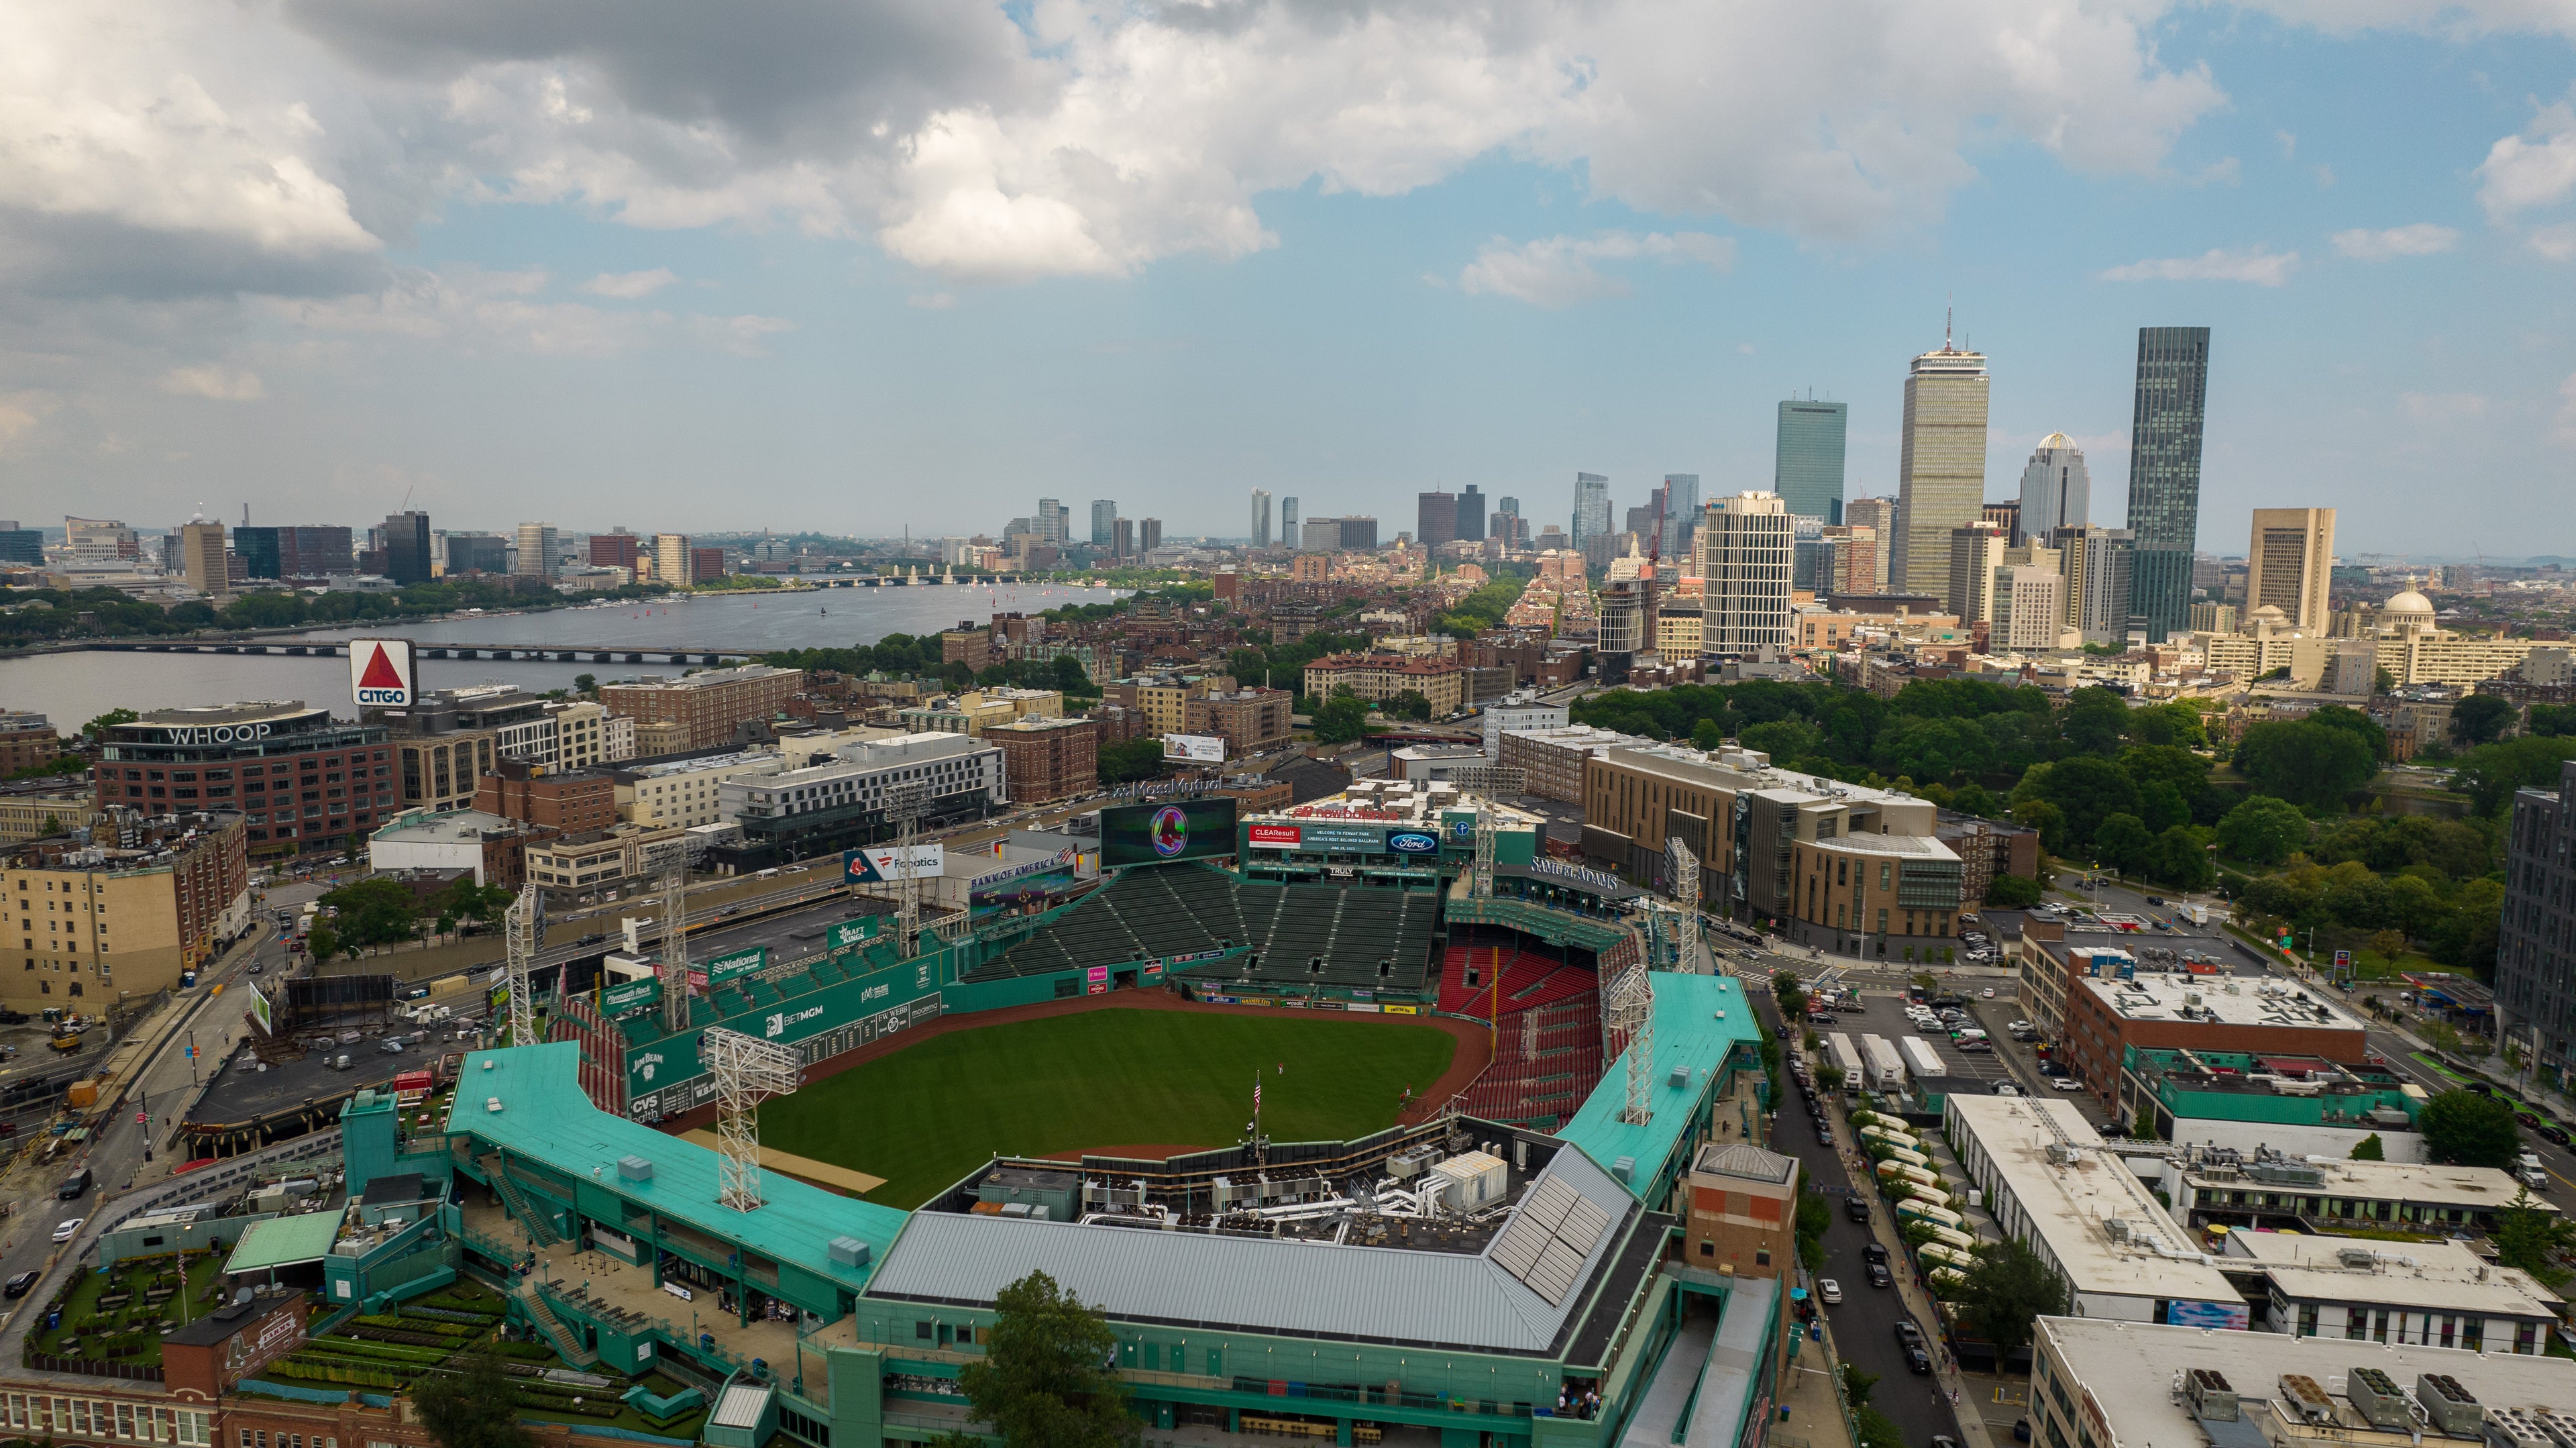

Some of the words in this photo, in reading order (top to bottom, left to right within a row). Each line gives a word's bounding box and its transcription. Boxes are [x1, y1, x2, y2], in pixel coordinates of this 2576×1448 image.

[359, 690, 405, 704] CITGO
[168, 724, 271, 745] WHOOP
[1133, 775, 1224, 797] MassMutual
[1316, 809, 1341, 819] new
[1344, 807, 1399, 821] balance
[1399, 837, 1426, 848] Ford
[971, 875, 998, 888] BANK
[1000, 870, 1013, 882] OF
[1014, 858, 1055, 876] AMERICA
[1532, 856, 1576, 879] SAMUEL
[1577, 865, 1617, 891] ADAMS
[840, 926, 865, 939] DRAFT
[843, 933, 865, 944] KINGS
[723, 951, 761, 972] National
[745, 962, 759, 970] Rental
[606, 989, 635, 1004] Plymouth
[635, 984, 651, 996] Rock
[784, 1005, 823, 1026] BETMGM
[890, 1005, 908, 1017] WEBB
[912, 1002, 938, 1017] moderna
[633, 1057, 645, 1073] JIM
[645, 1052, 663, 1064] BEAM
[633, 1095, 658, 1113] CVS
[264, 1321, 290, 1341] FARMS
